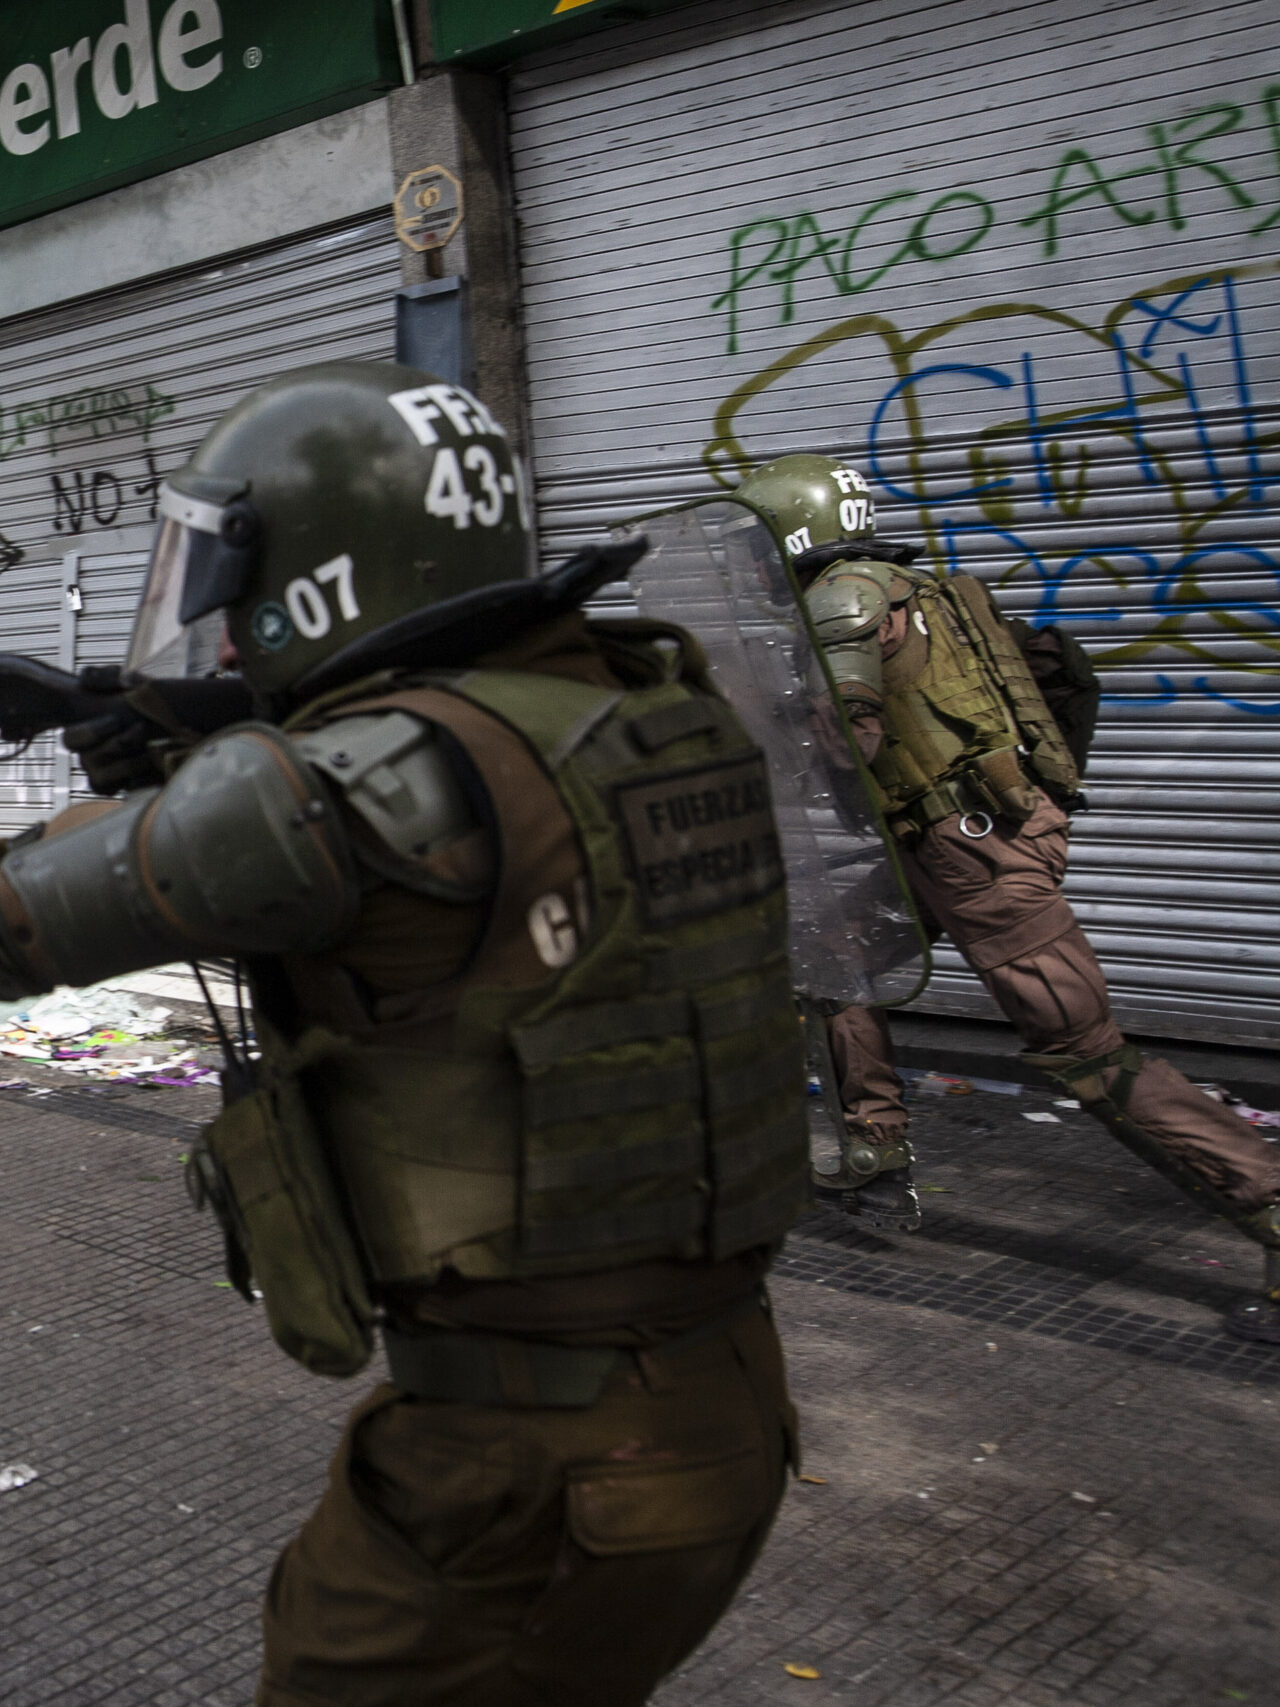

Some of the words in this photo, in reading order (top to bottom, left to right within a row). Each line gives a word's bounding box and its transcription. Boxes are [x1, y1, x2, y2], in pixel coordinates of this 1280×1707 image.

[712, 188, 995, 354] PACO
[424, 445, 532, 531] 43-
[784, 526, 813, 555] 07
[284, 553, 361, 640] 07
[645, 778, 770, 836] FUERZA
